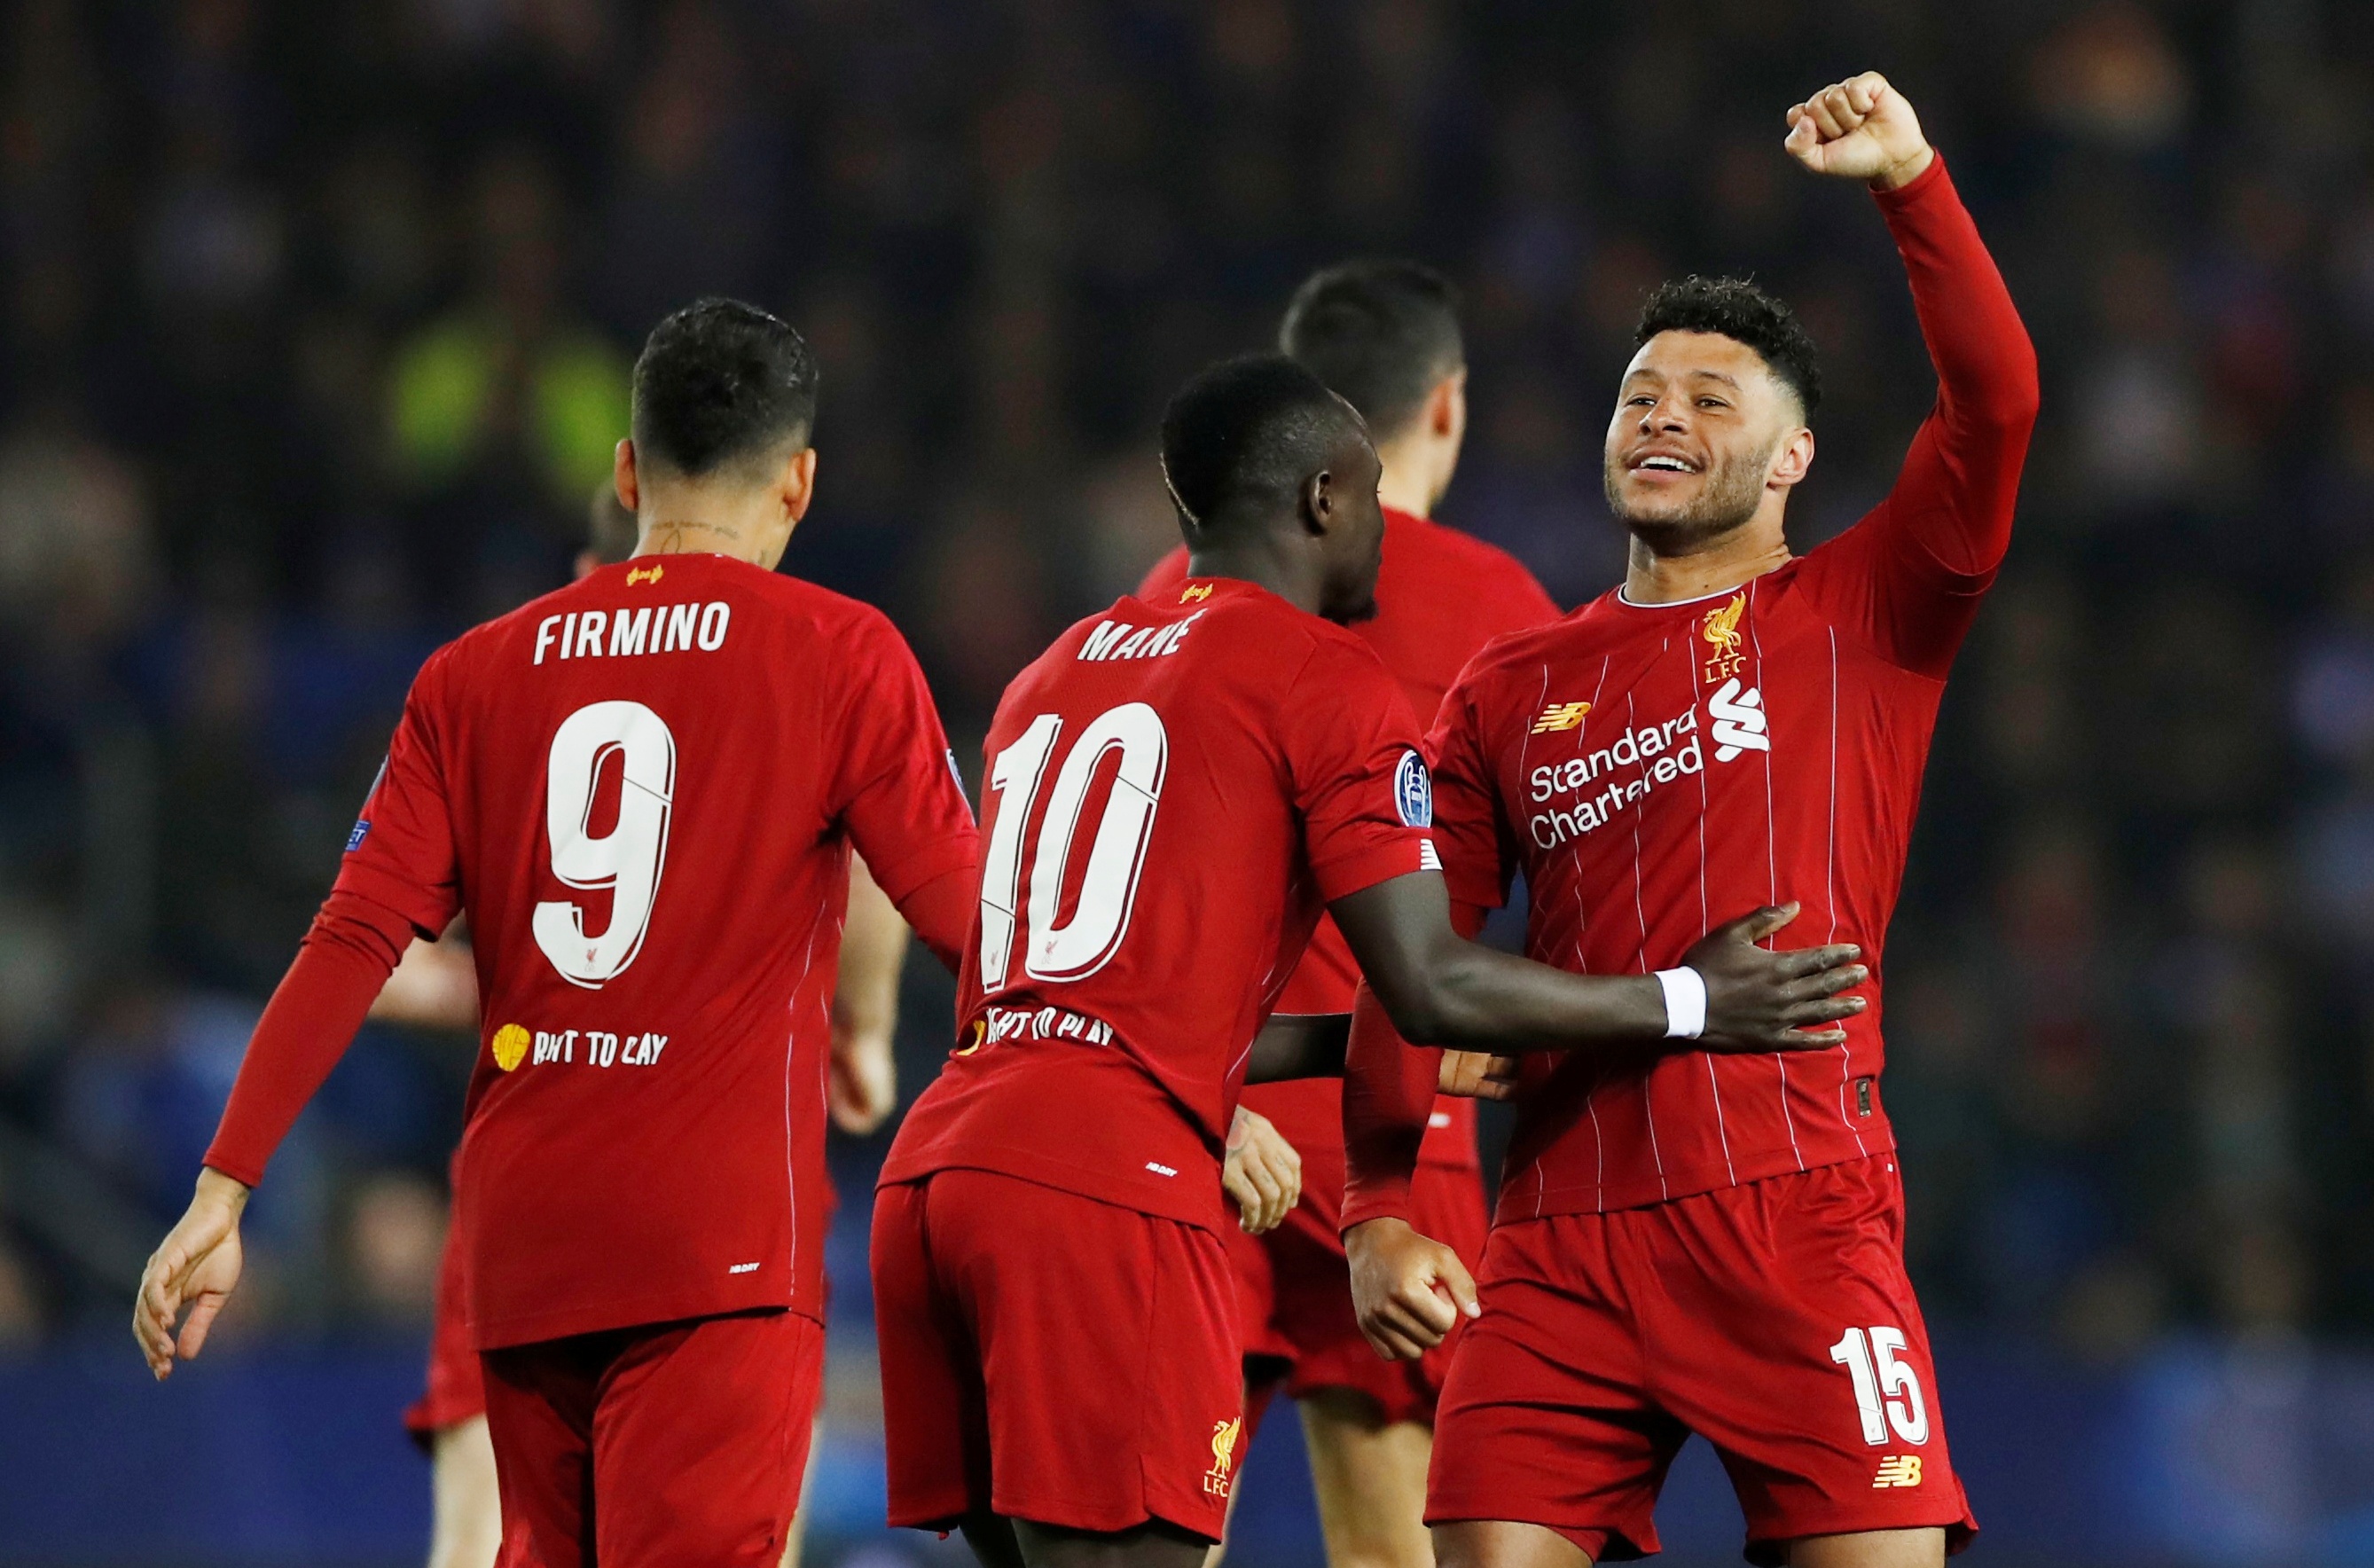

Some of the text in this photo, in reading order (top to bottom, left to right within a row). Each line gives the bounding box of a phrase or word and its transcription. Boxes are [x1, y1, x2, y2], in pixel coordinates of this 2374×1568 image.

[533, 601, 731, 665] FIRMINO
[1530, 702, 1698, 803] Standard
[1530, 734, 1704, 850] Chartered
[532, 700, 677, 989] 9
[980, 702, 1168, 994] 10
[585, 1031, 618, 1068] TO
[1057, 1013, 1114, 1047] PLAY
[1829, 1326, 1930, 1446] 15
